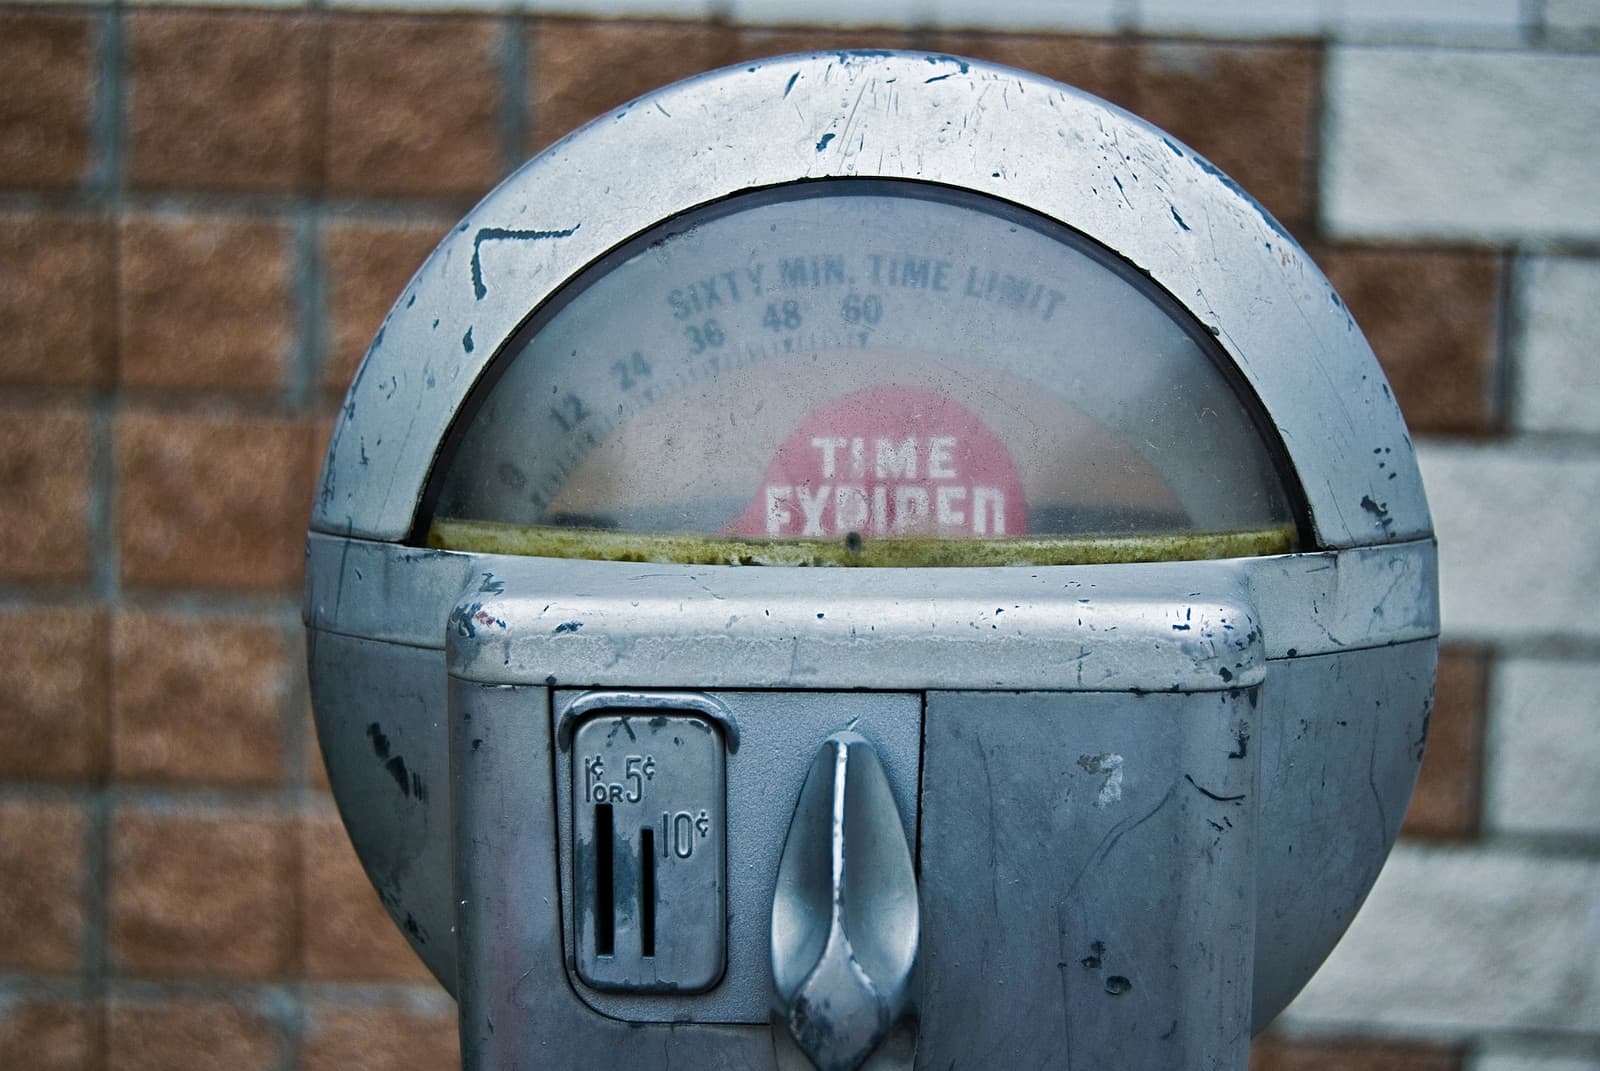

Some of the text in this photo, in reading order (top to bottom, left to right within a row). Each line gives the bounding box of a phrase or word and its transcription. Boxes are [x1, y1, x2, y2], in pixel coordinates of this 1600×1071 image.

[667, 263, 767, 321] SIXTY
[868, 253, 953, 292] TIME
[962, 263, 1067, 322] LIMIT
[550, 394, 589, 432] 12
[686, 319, 725, 353] 36
[763, 301, 801, 333] 48
[841, 294, 882, 325] 60
[811, 436, 958, 479] TIME
[592, 785, 623, 803] OR
[662, 811, 709, 858] 10¢
